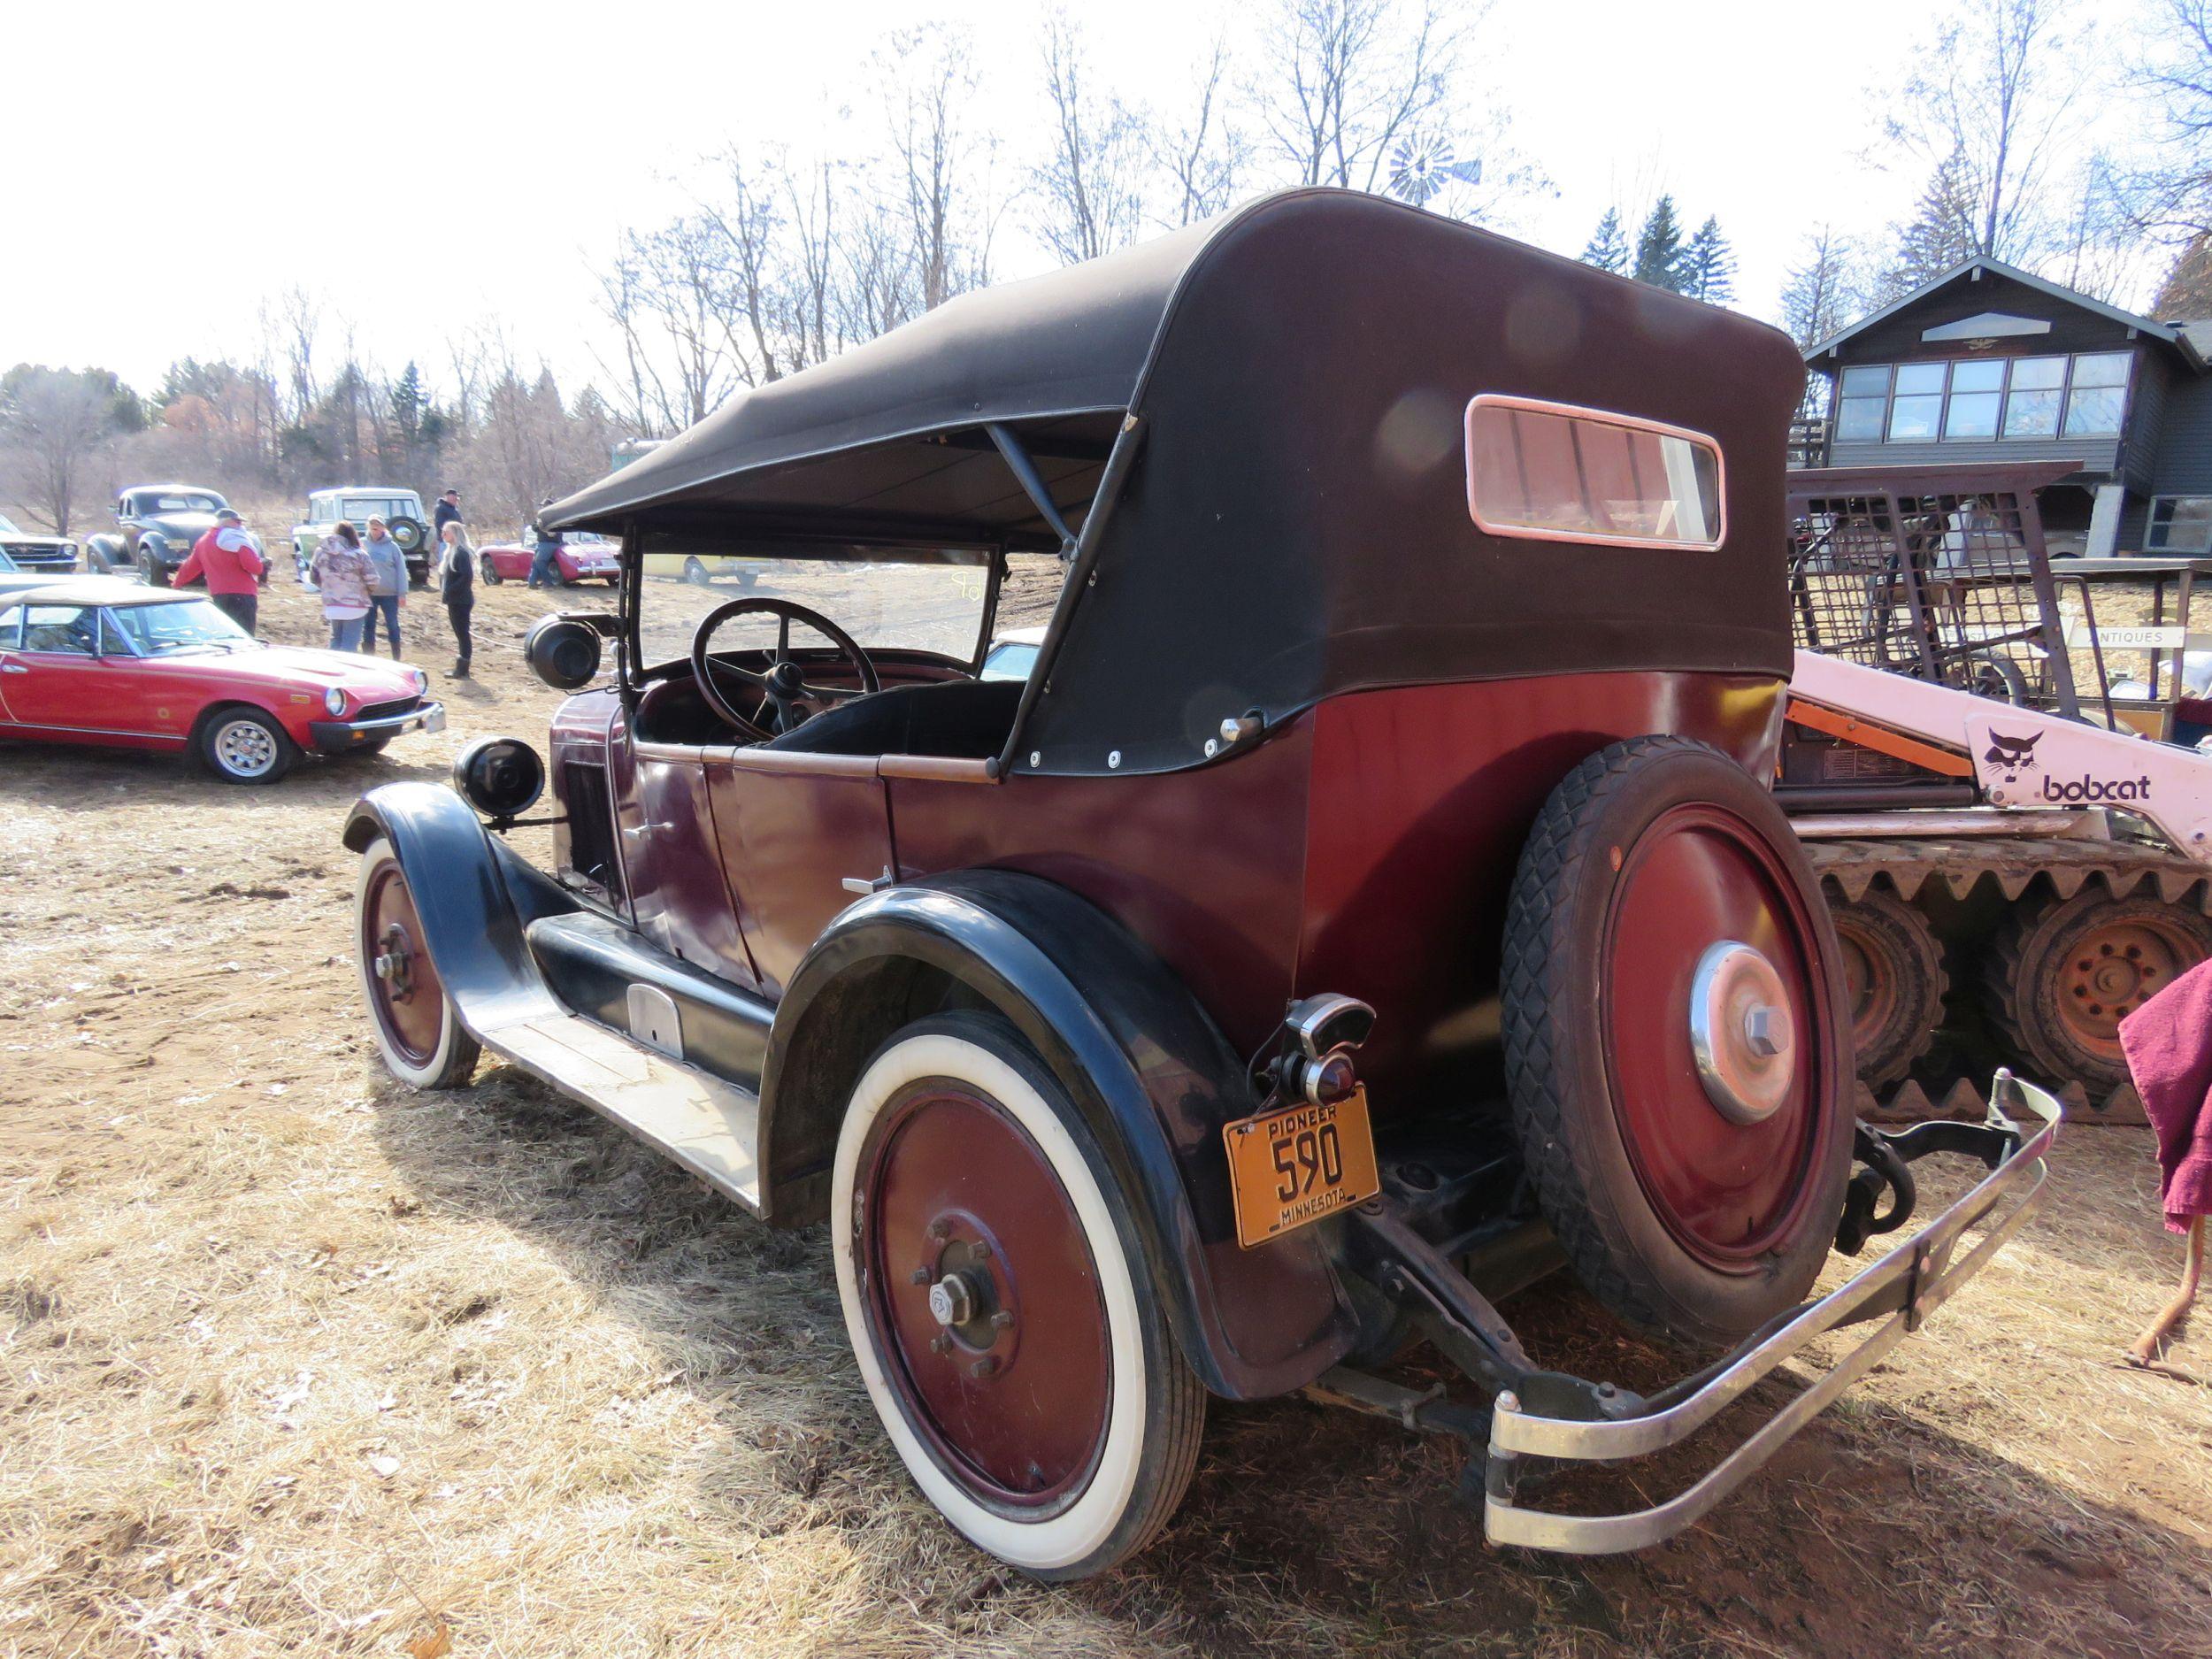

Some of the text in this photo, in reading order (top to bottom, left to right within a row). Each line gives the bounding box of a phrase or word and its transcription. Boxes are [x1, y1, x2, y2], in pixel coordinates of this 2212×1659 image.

[2089, 632, 2163, 643] NTIQUES
[2043, 773, 2151, 802] bobcat
[1267, 1105, 1338, 1139] PIONEER
[1271, 1122, 1343, 1204] 590
[1279, 1187, 1347, 1225] MINNESOTA
